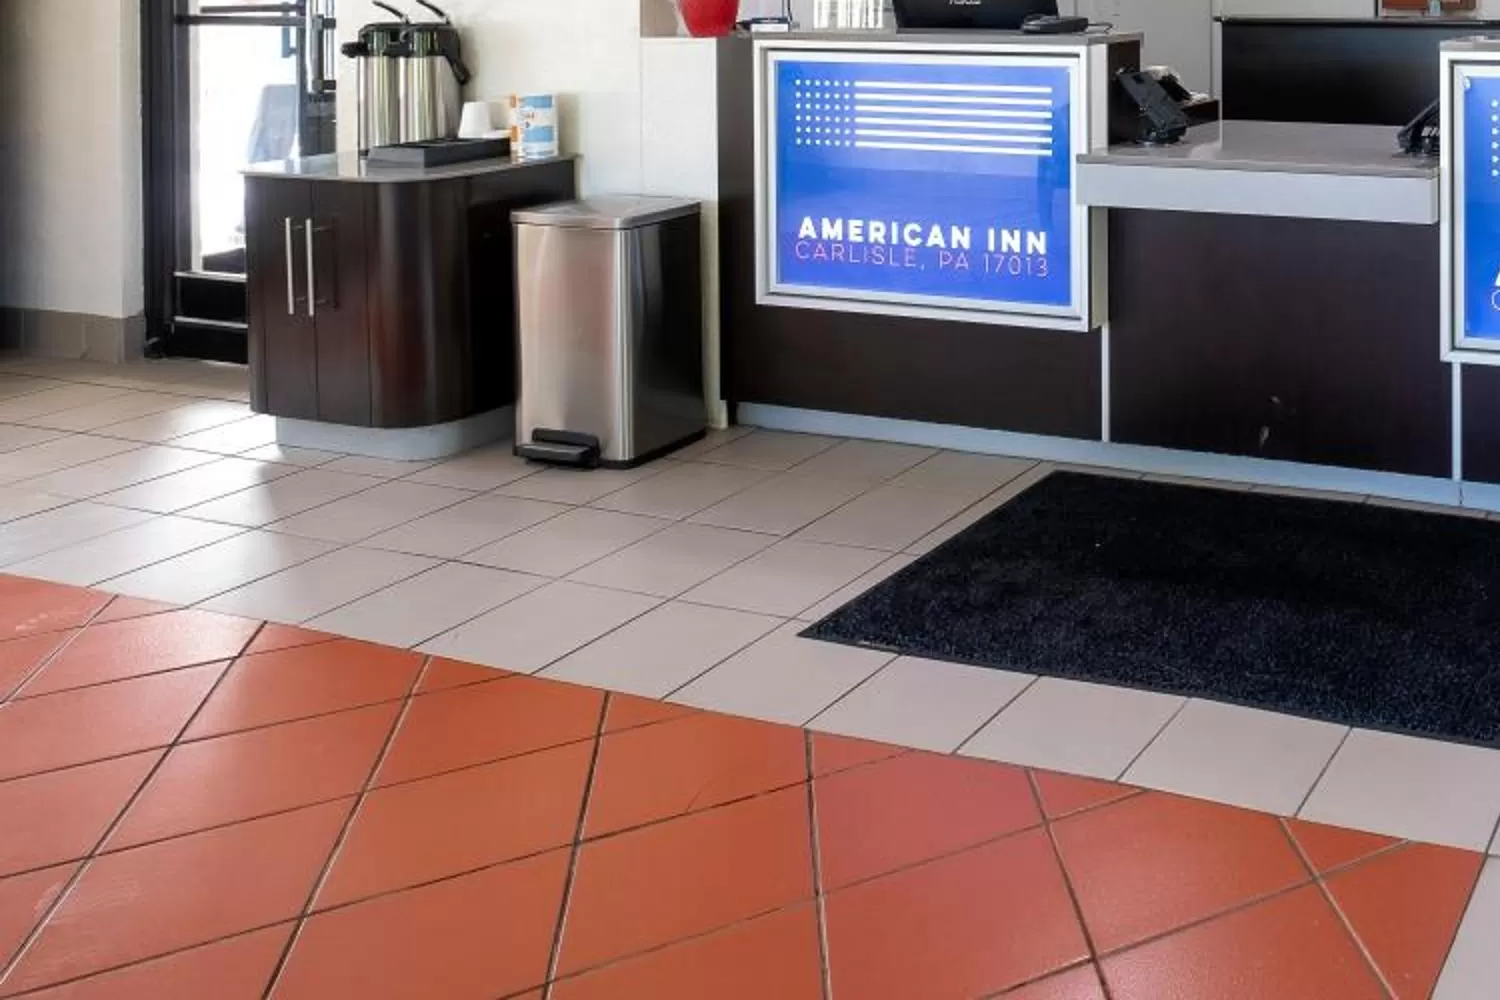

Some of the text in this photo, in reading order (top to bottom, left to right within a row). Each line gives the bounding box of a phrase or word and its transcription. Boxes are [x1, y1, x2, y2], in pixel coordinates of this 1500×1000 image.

[798, 215, 1048, 256] AMERICAN INN
[794, 240, 1050, 278] CARLISLE, PA 17013
